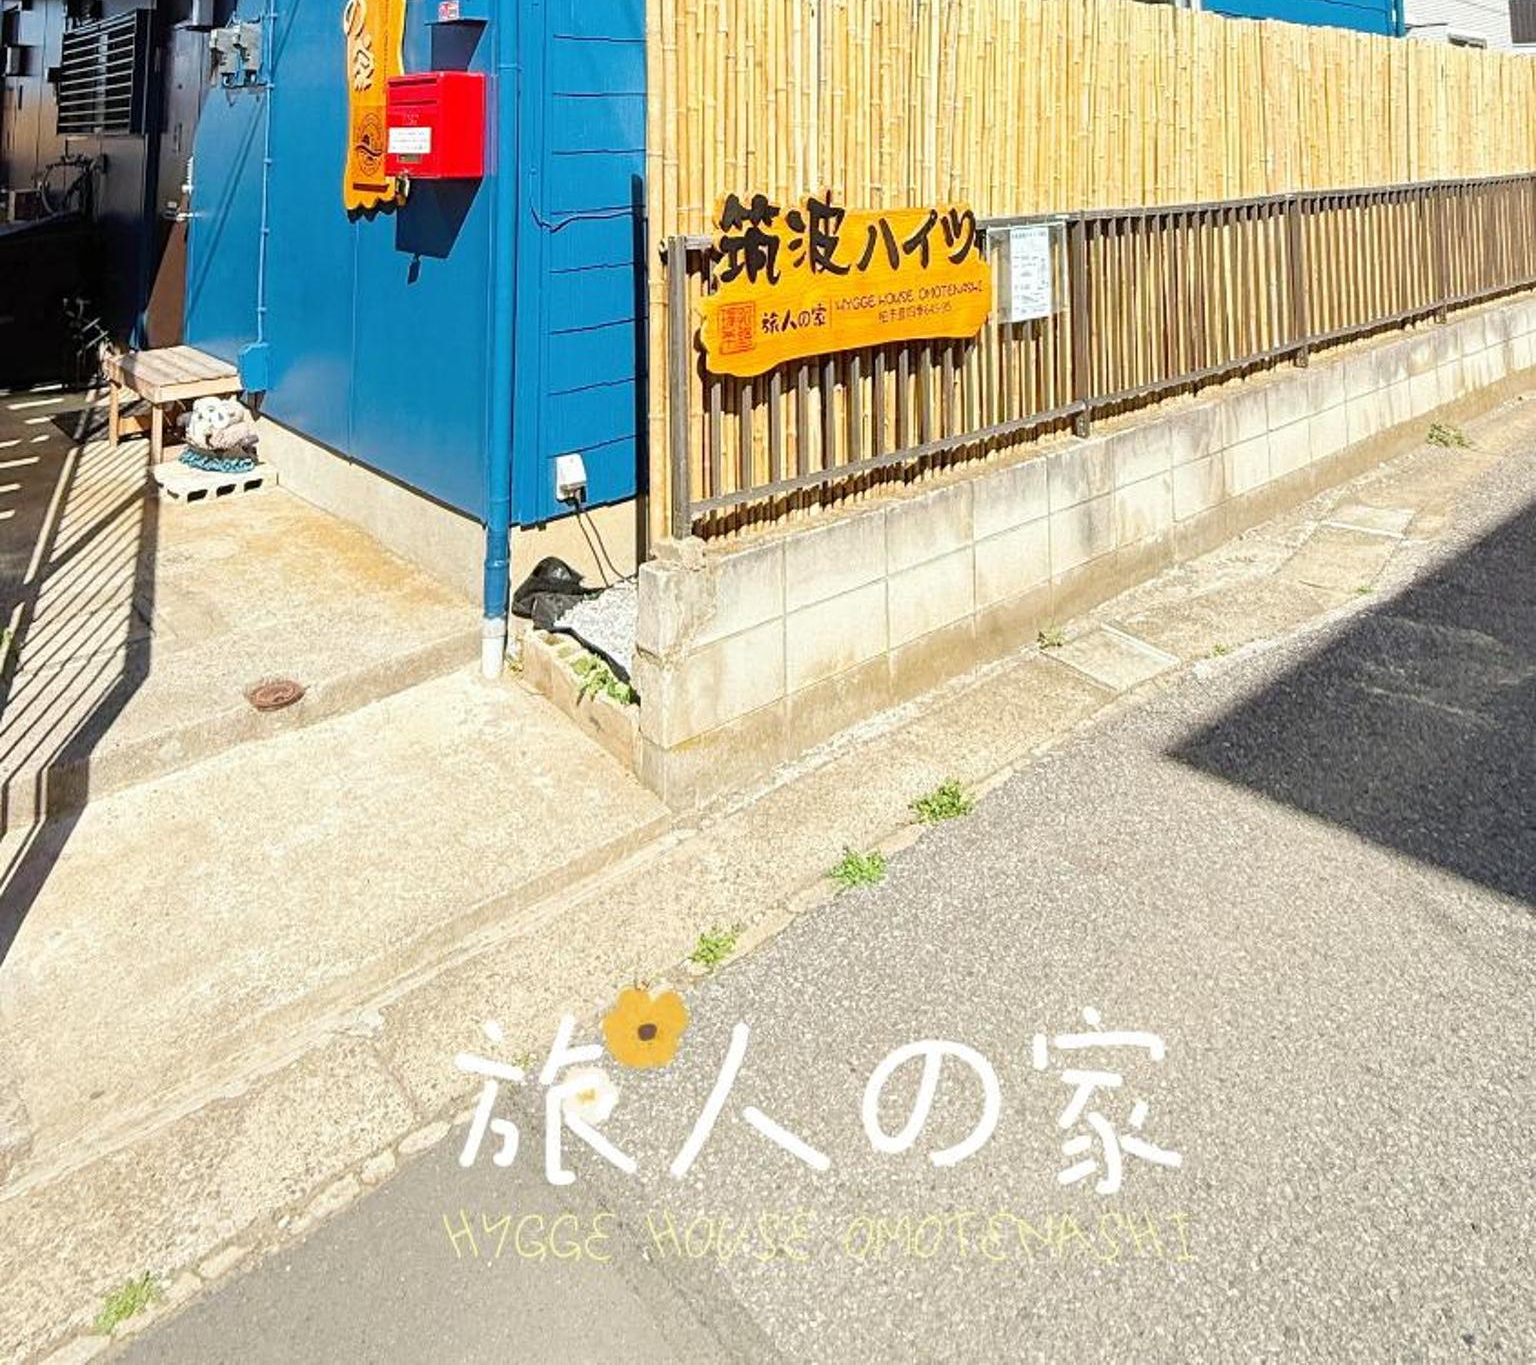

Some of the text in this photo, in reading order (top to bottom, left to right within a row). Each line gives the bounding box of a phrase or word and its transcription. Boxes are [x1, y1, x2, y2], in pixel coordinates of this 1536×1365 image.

[717, 189, 978, 287] 筑波ハイツ
[761, 302, 827, 334] 旅人の家
